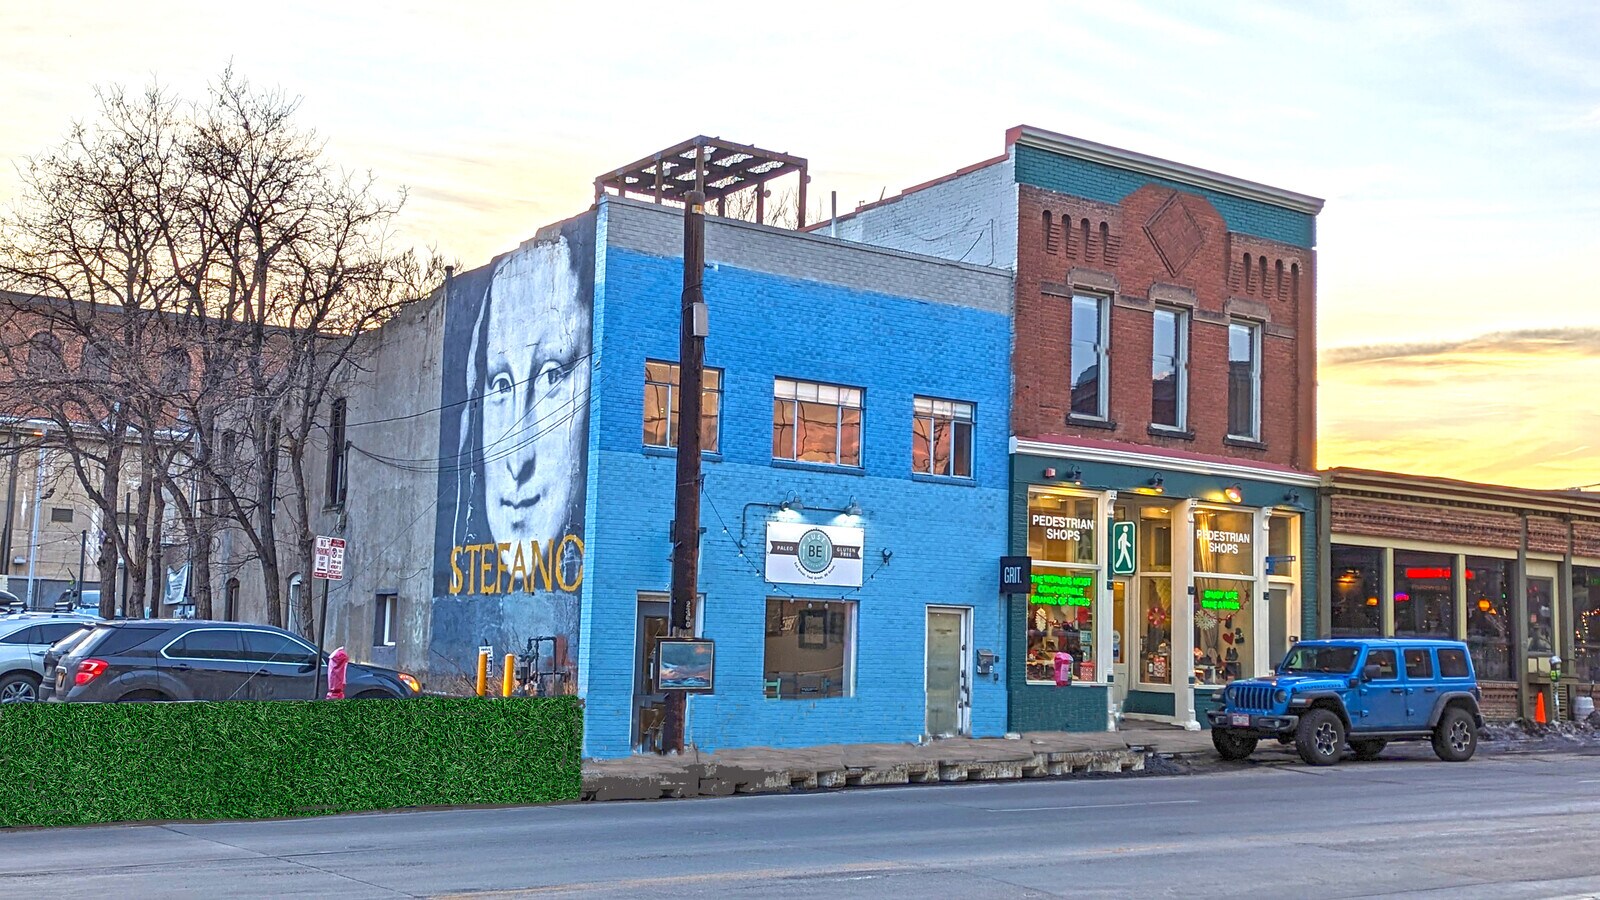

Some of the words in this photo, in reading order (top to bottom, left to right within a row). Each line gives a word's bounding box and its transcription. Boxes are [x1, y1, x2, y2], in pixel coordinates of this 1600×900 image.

[1032, 514, 1094, 530] PEDESTRIAN
[807, 534, 826, 542] JUST
[1046, 528, 1081, 541] SHOPS
[1196, 529, 1250, 543] PEDESTRIAN
[808, 545, 823, 557] BE
[1209, 542, 1239, 554] SHOPS
[449, 534, 584, 595] STEFANO
[1004, 566, 1023, 584] GRIT.
[1030, 575, 1044, 585] THE
[1073, 577, 1092, 586] MOST
[1030, 595, 1057, 605] BRANDS
[1057, 596, 1068, 606] OF
[1068, 597, 1091, 607] SHOES
